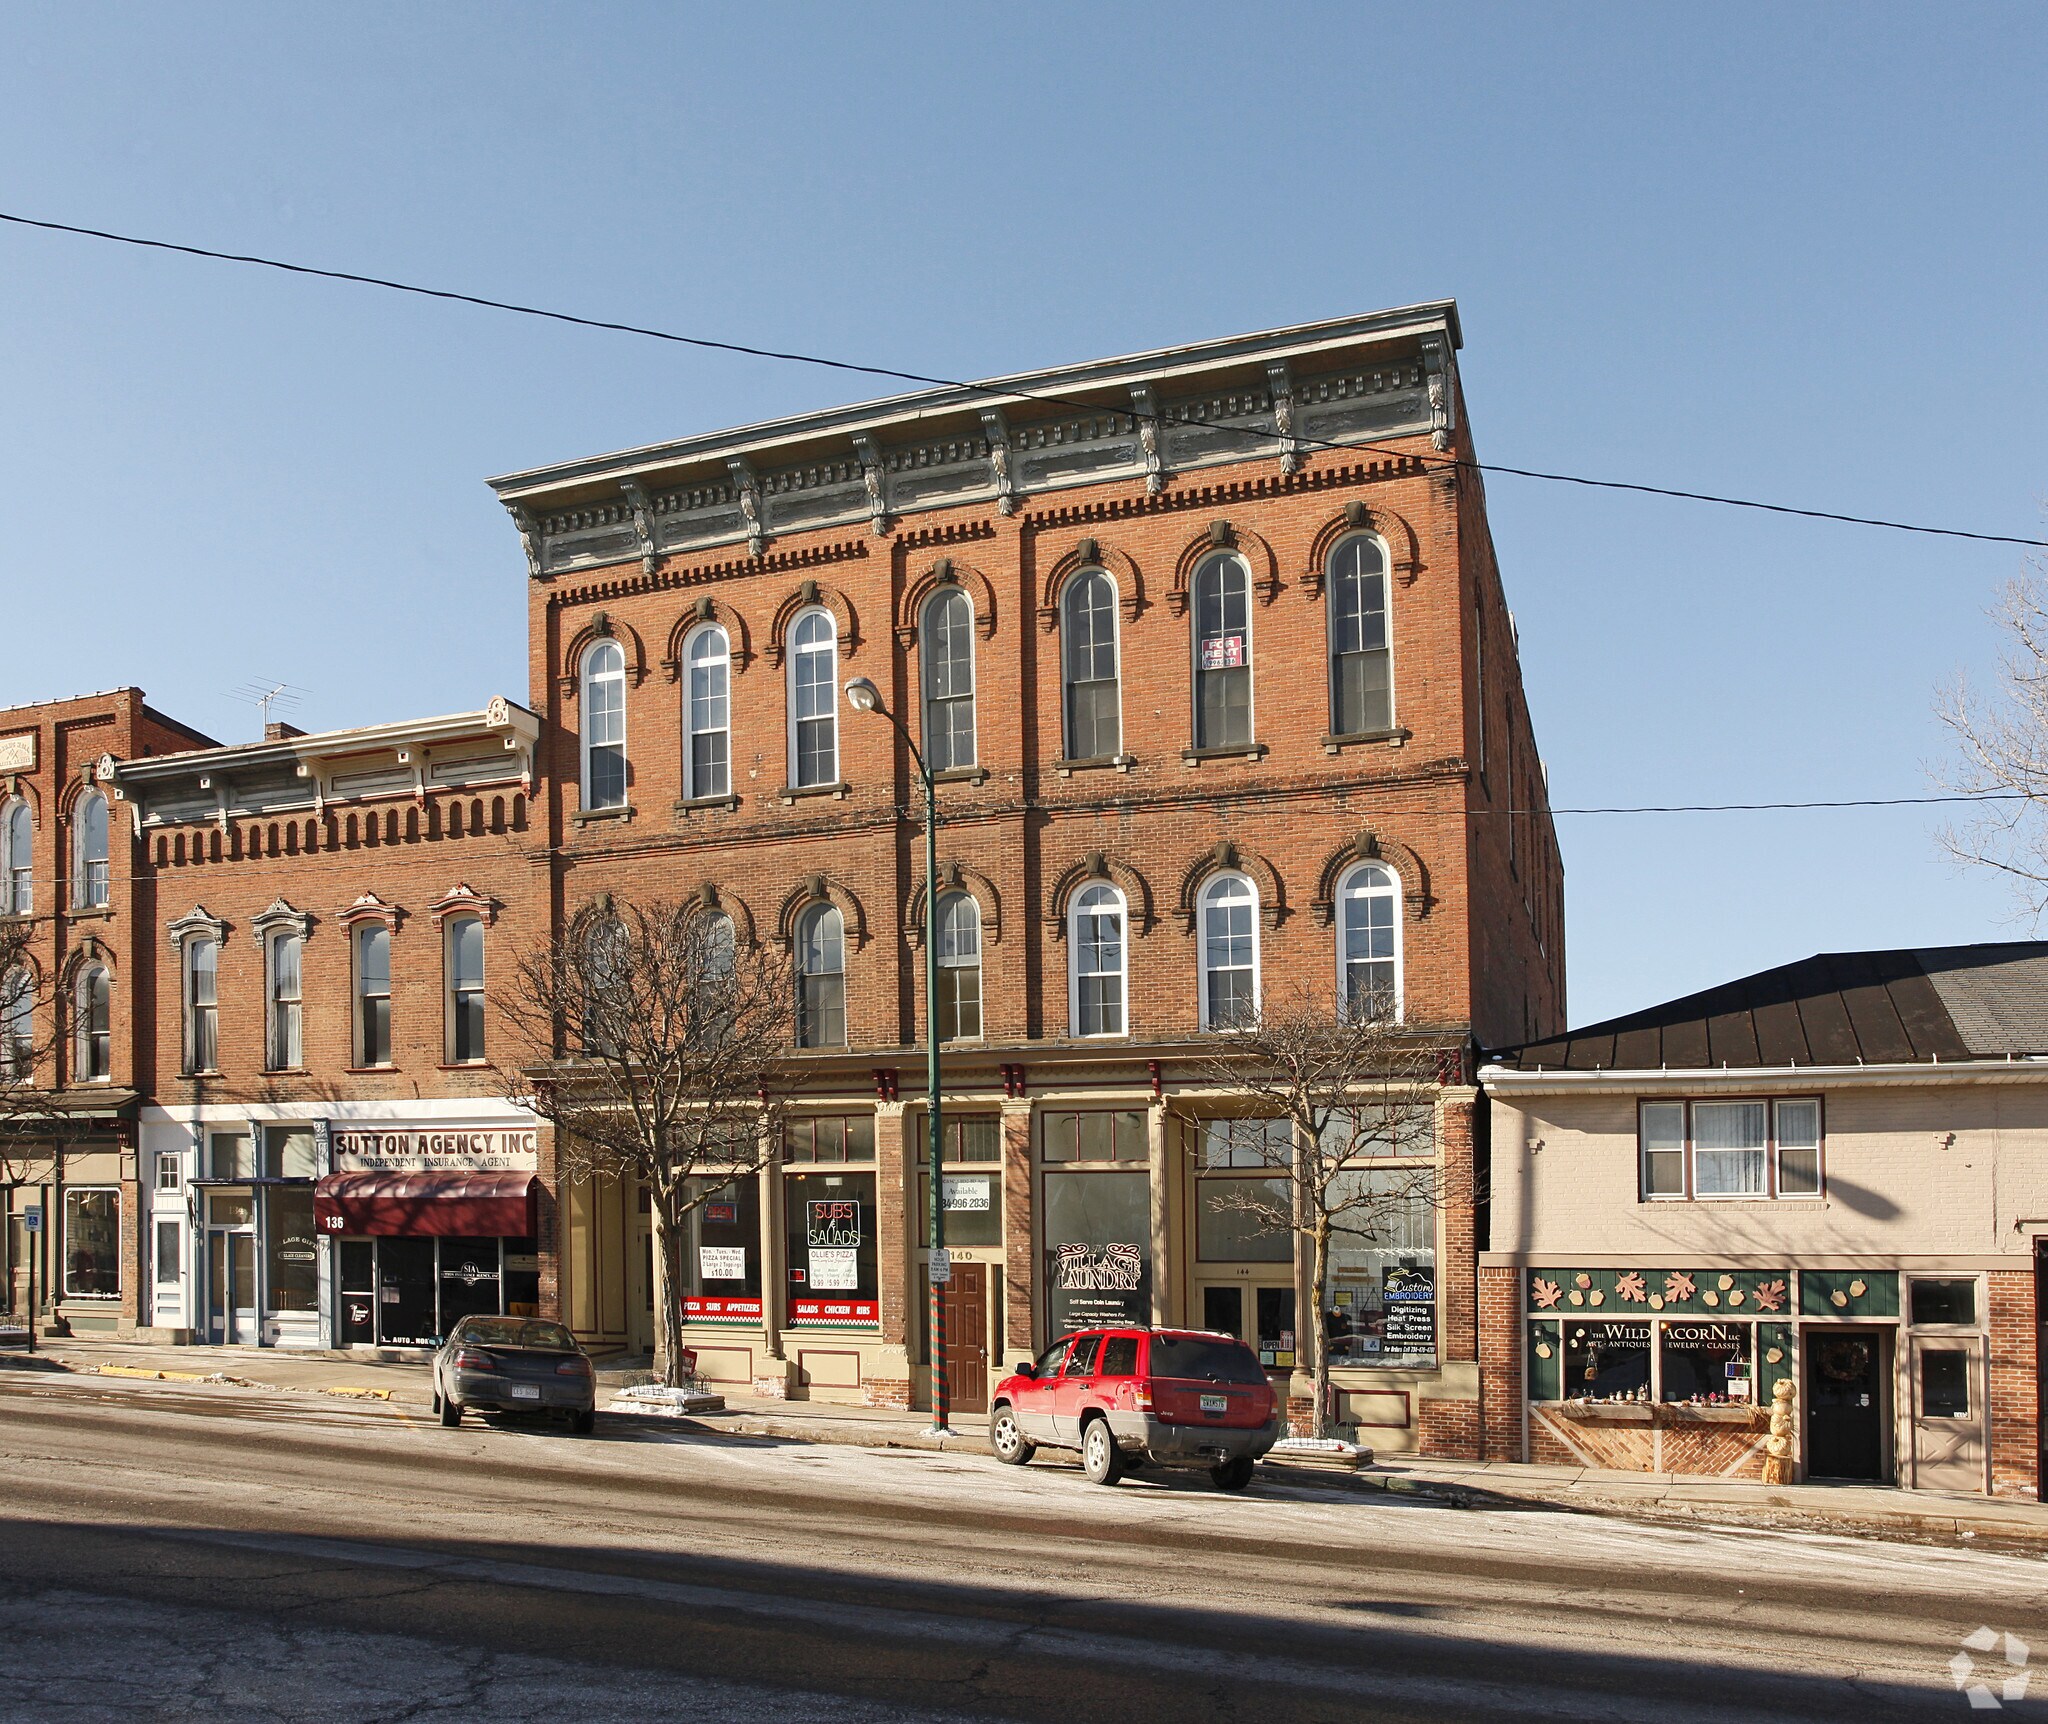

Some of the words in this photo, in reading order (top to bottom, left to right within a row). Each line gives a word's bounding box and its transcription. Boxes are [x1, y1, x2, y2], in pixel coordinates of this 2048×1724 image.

[1208, 639, 1235, 650] FOR
[1204, 647, 1239, 658] RENT
[335, 1134, 411, 1156] SUTTON
[360, 1157, 416, 1168] INDEPENDENT
[424, 1156, 474, 1168] INSURANCE
[481, 1156, 511, 1168] AGENT
[948, 1186, 978, 1195] Available
[814, 1202, 853, 1219] SUBS
[325, 1215, 344, 1230] 136
[809, 1229, 860, 1246] SALADS
[810, 1250, 835, 1259] OLLIE'S
[836, 1250, 854, 1259] PIZZA
[950, 1251, 973, 1261] 140
[463, 1264, 477, 1274] SIA
[1056, 1253, 1141, 1275] VILLAGE
[711, 1268, 734, 1277] $10.00
[1236, 1268, 1250, 1276] 144
[1056, 1268, 1141, 1291] LAUNDRY
[1395, 1280, 1434, 1293] Custom
[1384, 1291, 1433, 1300] EMBROIDERY
[683, 1301, 700, 1311] PIZZA
[705, 1302, 721, 1311] SUBS
[726, 1303, 760, 1313] APPETIZERS
[1079, 1298, 1093, 1306] Serve
[1105, 1299, 1125, 1307] Laundry
[796, 1304, 819, 1314] SALADS
[824, 1305, 851, 1315] CHICKEN
[856, 1306, 871, 1315] RIBS
[1391, 1305, 1428, 1315] Digitizing
[1387, 1314, 1406, 1322] Heat
[1408, 1315, 1431, 1323] Press
[1386, 1323, 1401, 1331] Silk
[1404, 1323, 1432, 1331] Screen
[1592, 1332, 1605, 1340] THE
[1604, 1323, 1651, 1340] WILD
[392, 1336, 411, 1345] AUTO
[1386, 1332, 1432, 1341] Embroidery
[1263, 1341, 1280, 1350] OPEN
[1608, 1341, 1651, 1350] ANTIQUES
[1706, 1342, 1741, 1350] CLASSES
